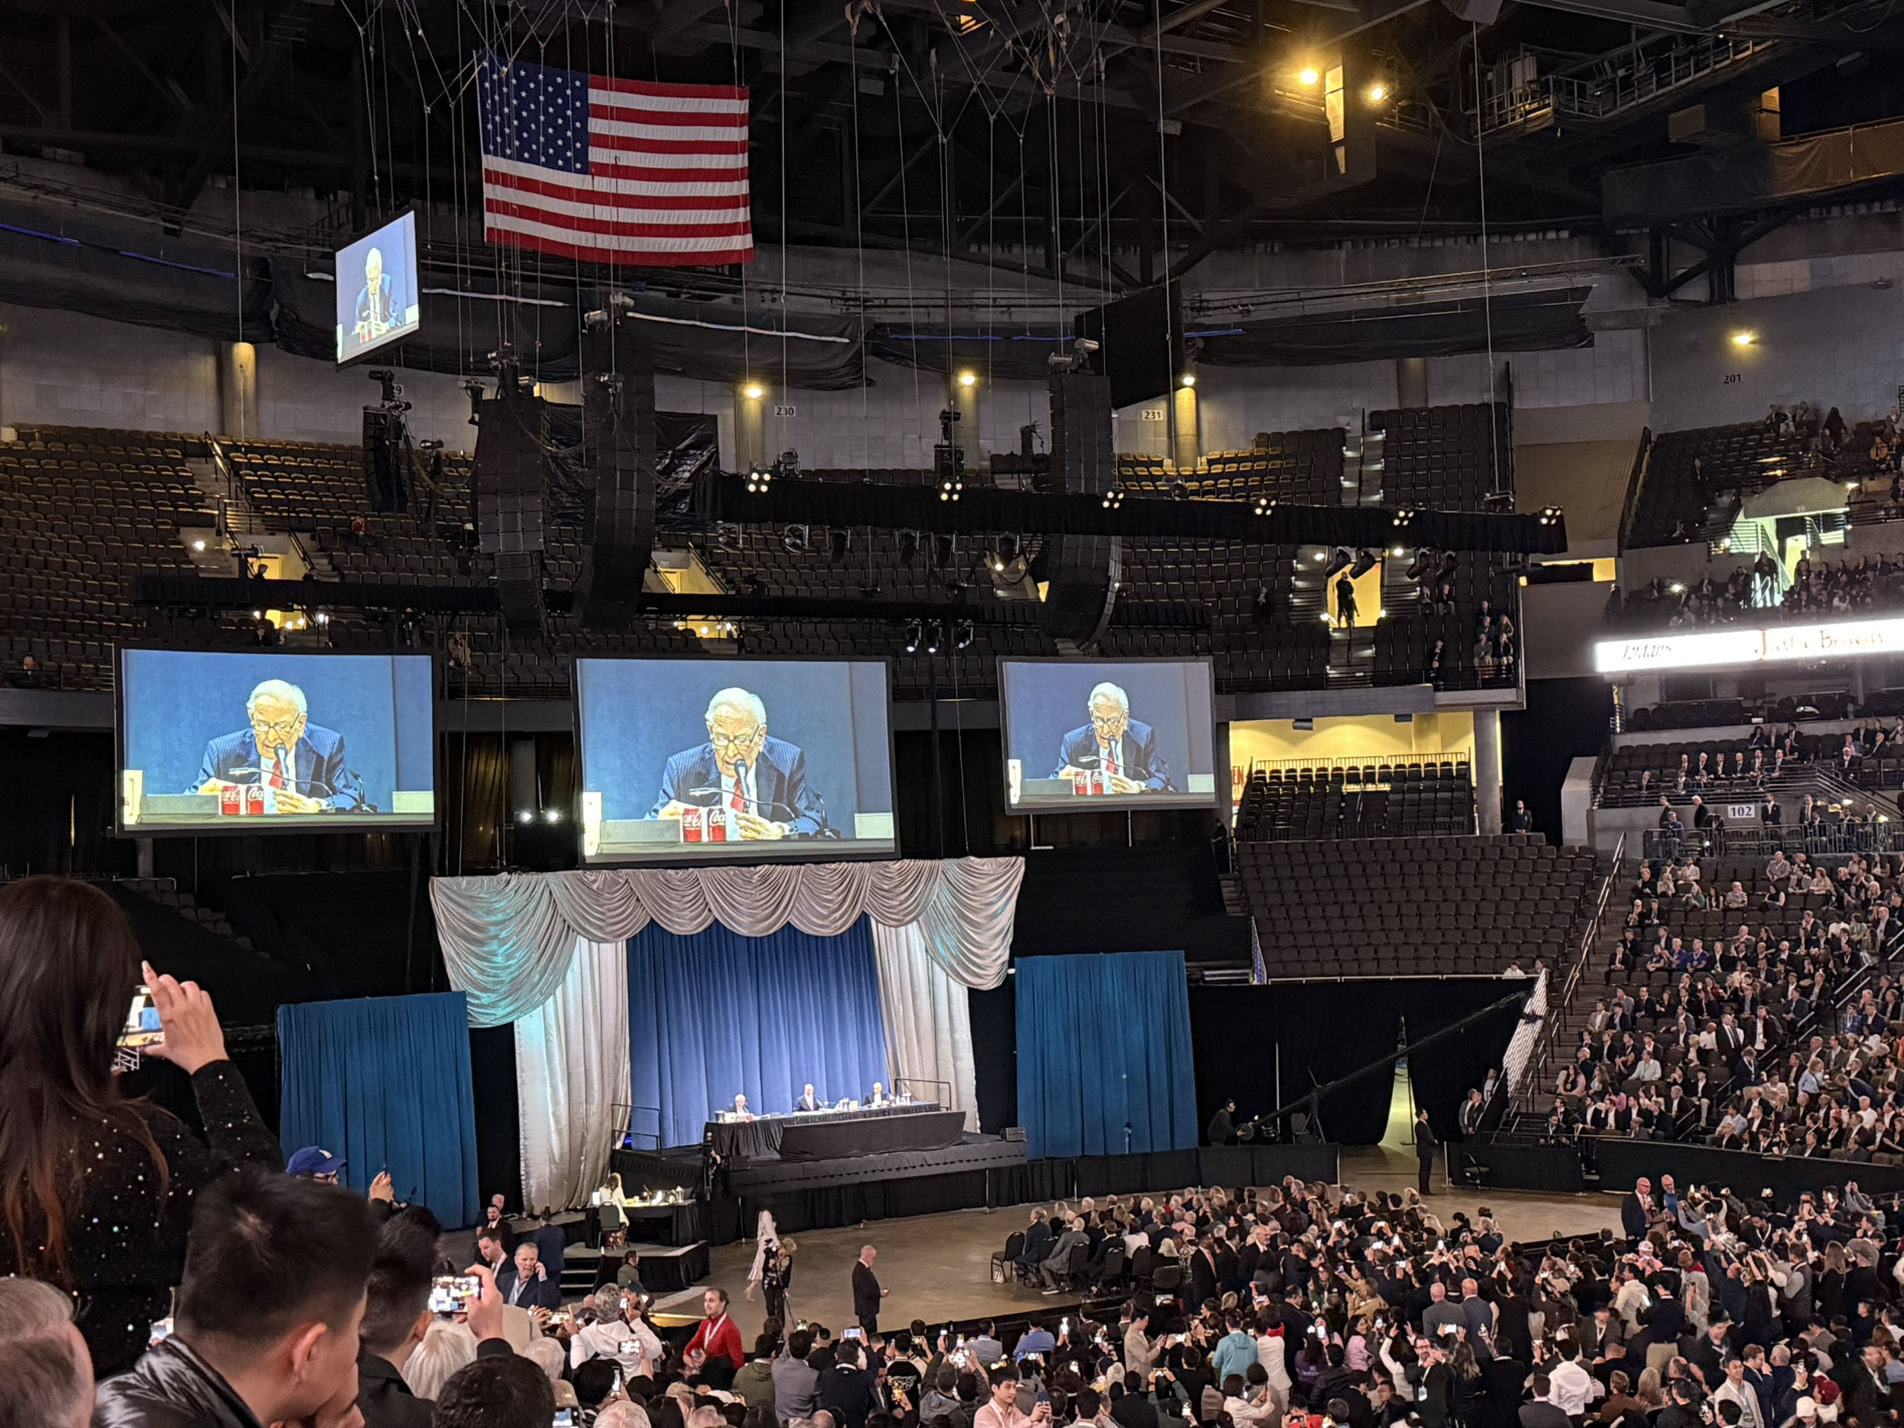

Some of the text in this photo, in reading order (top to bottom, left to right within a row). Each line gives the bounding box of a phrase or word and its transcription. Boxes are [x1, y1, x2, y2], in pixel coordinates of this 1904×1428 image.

[1723, 374, 1741, 384] 201
[776, 406, 795, 416] 230
[1144, 410, 1161, 420] 231
[1730, 806, 1753, 817] 102
